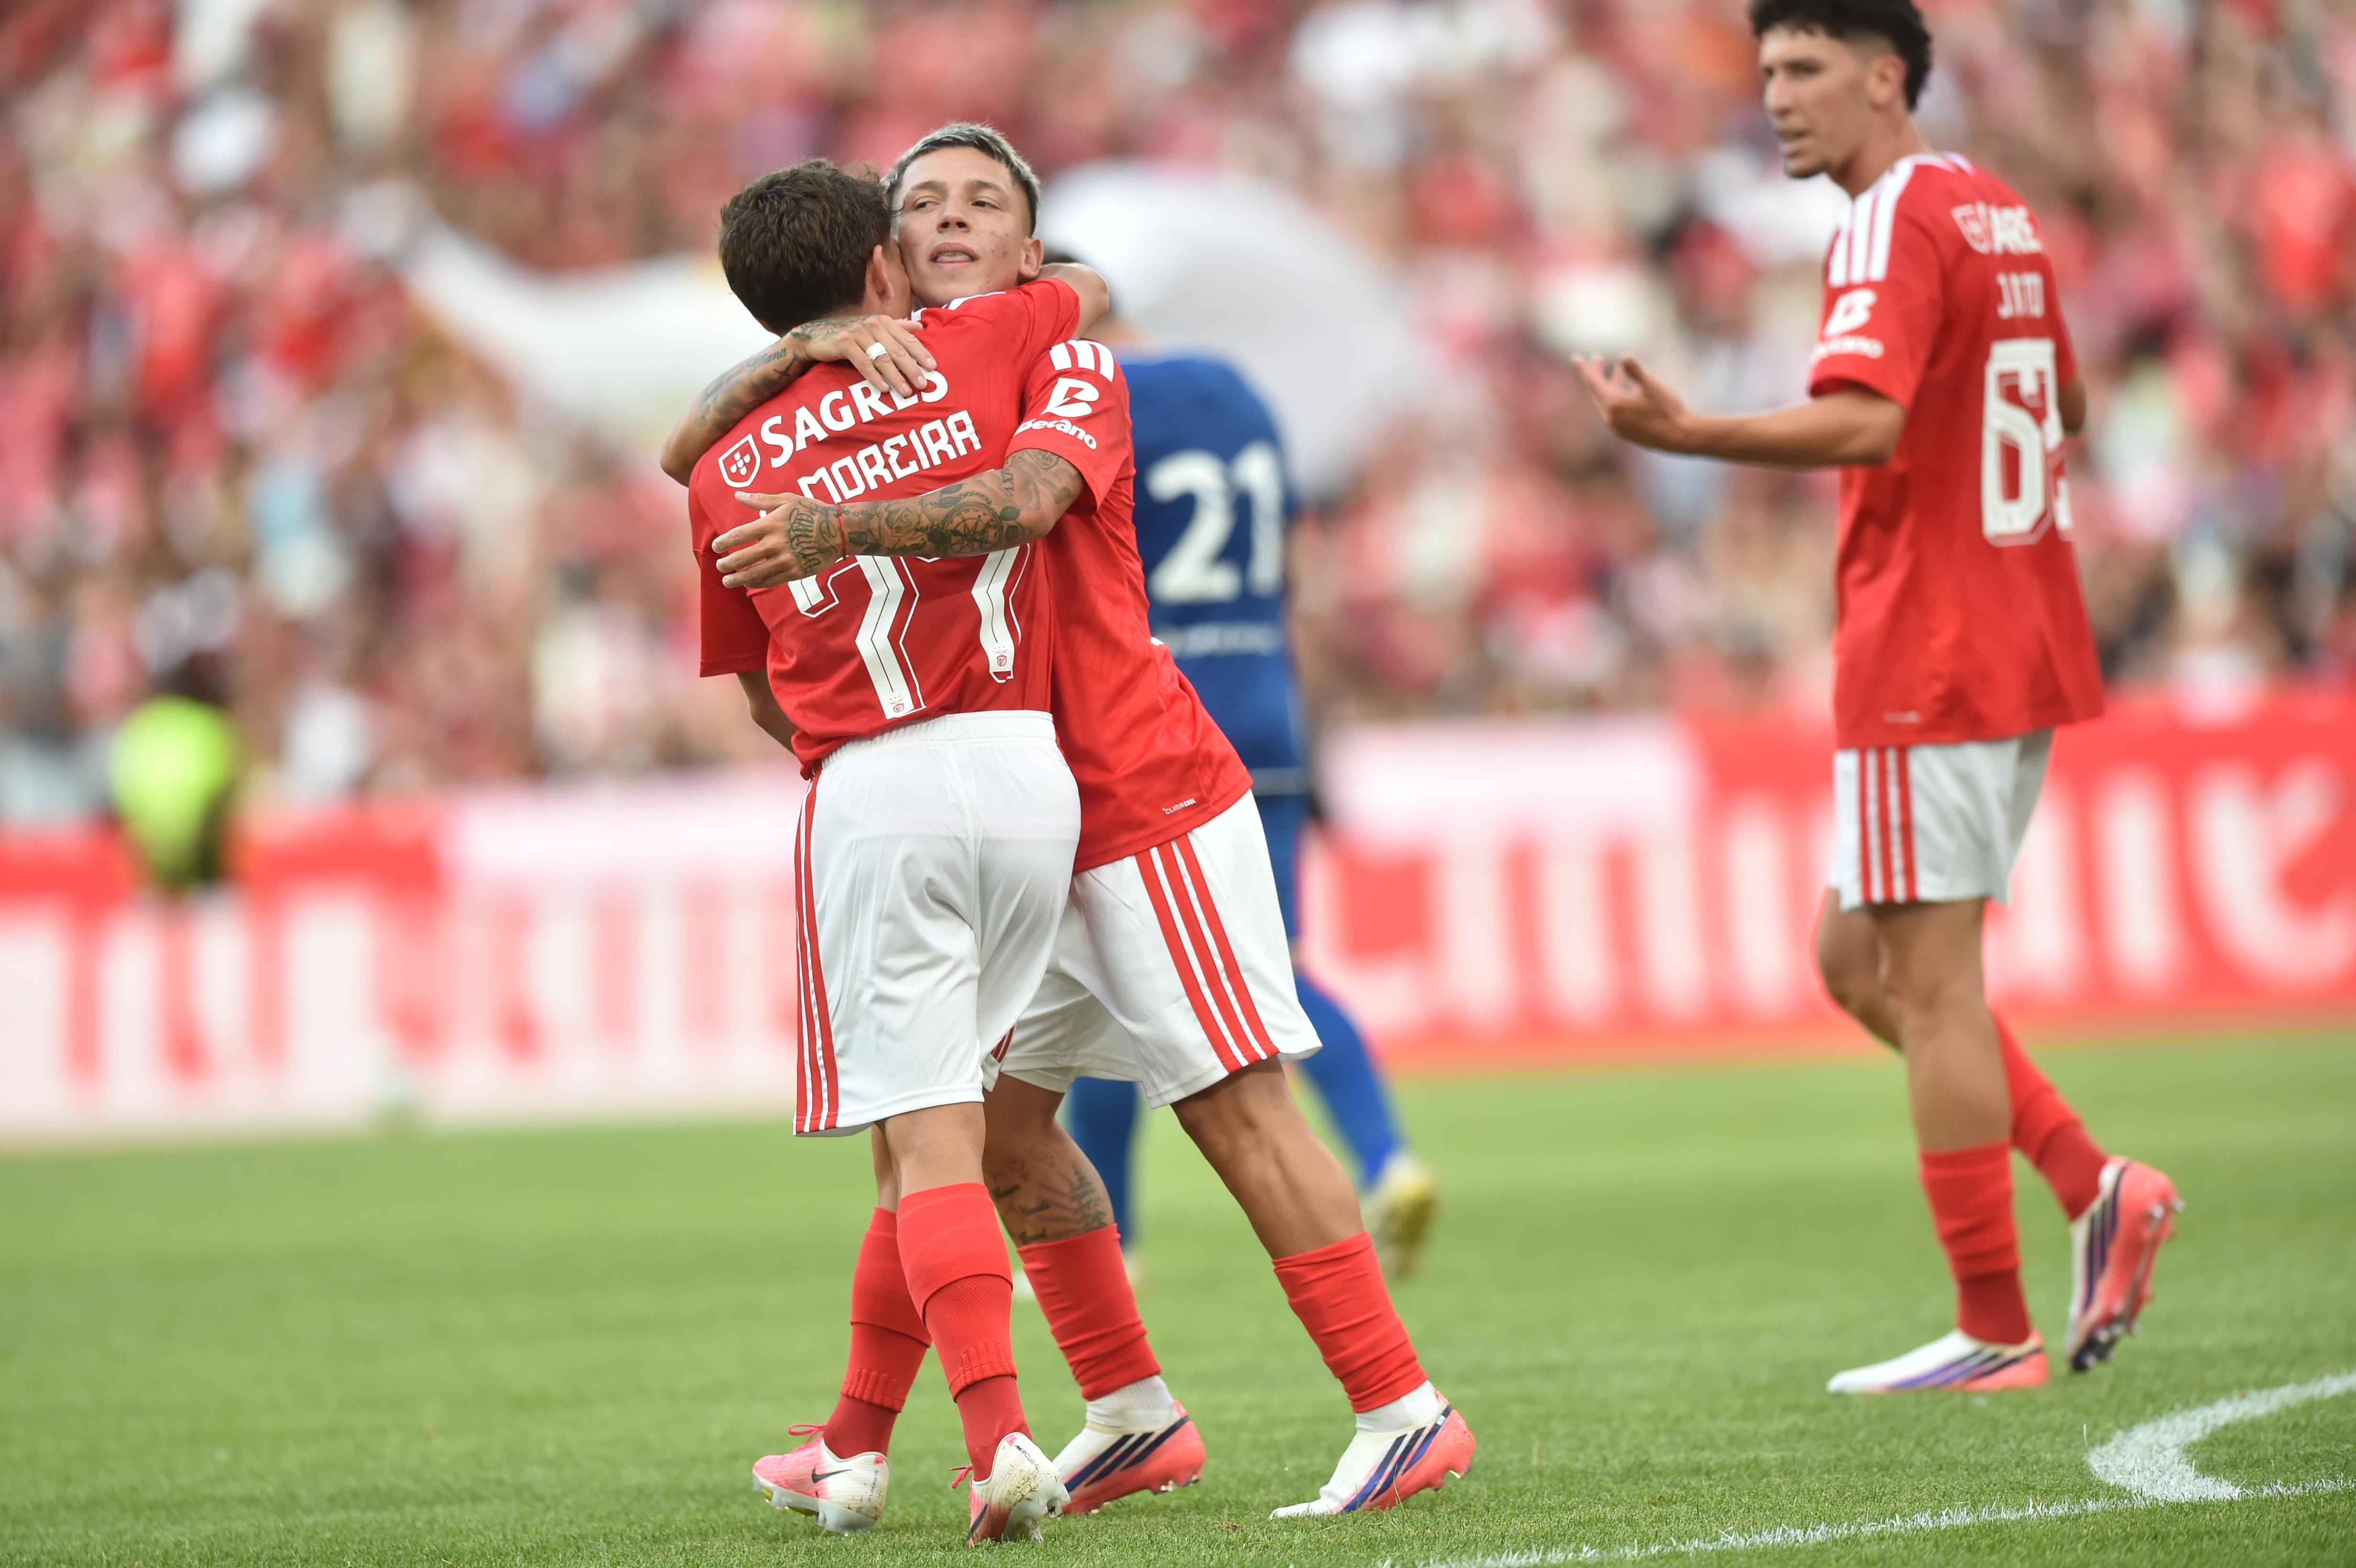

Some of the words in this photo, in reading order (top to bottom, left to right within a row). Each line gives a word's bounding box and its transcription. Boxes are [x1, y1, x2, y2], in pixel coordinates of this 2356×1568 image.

[1040, 378, 1100, 417] B
[797, 409, 982, 504] MOREIRA
[1146, 441, 1284, 604] 21
